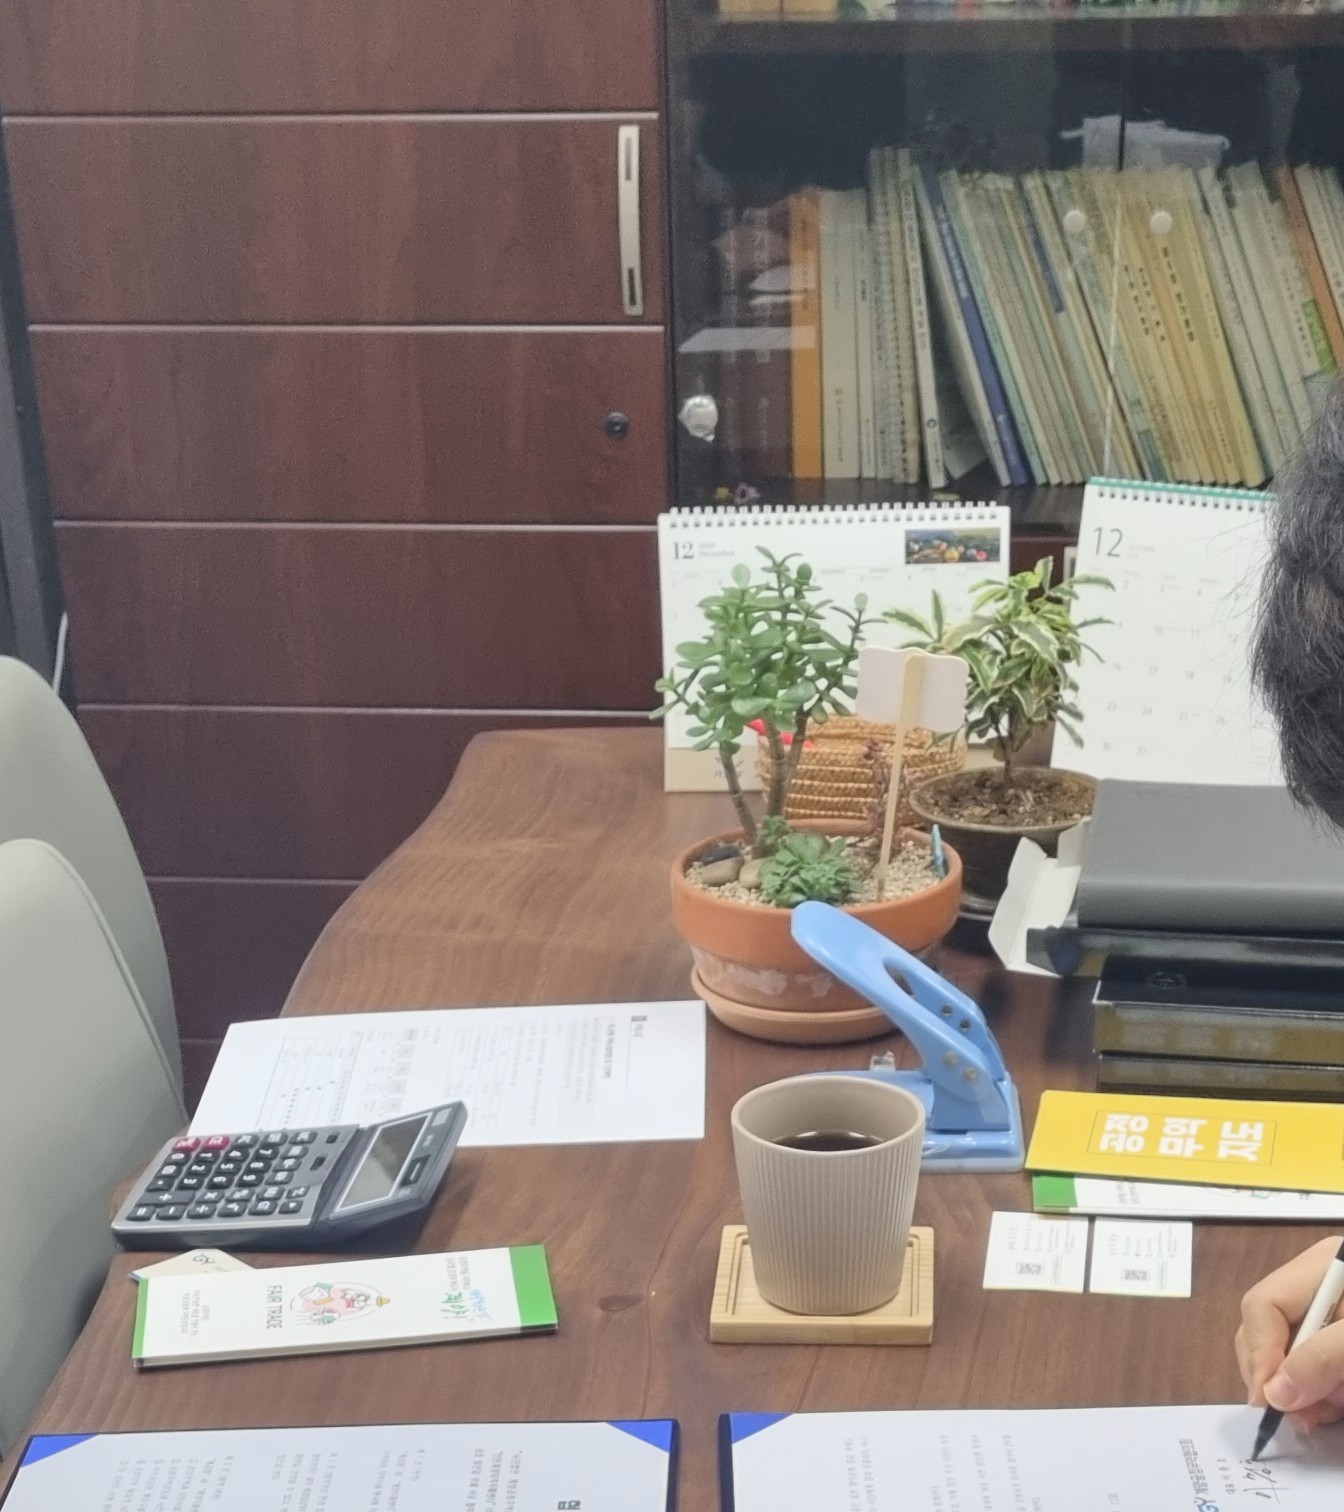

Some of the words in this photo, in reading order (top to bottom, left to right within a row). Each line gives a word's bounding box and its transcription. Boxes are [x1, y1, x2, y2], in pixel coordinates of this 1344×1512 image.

[672, 541, 696, 560] 12
[1093, 526, 1124, 558] 12
[1099, 1113, 1150, 1153] 공정
[1158, 1117, 1208, 1158] 무역
[1218, 1120, 1265, 1162] 지도
[266, 1285, 283, 1303] FAIR
[266, 1305, 283, 1329] TRADE
